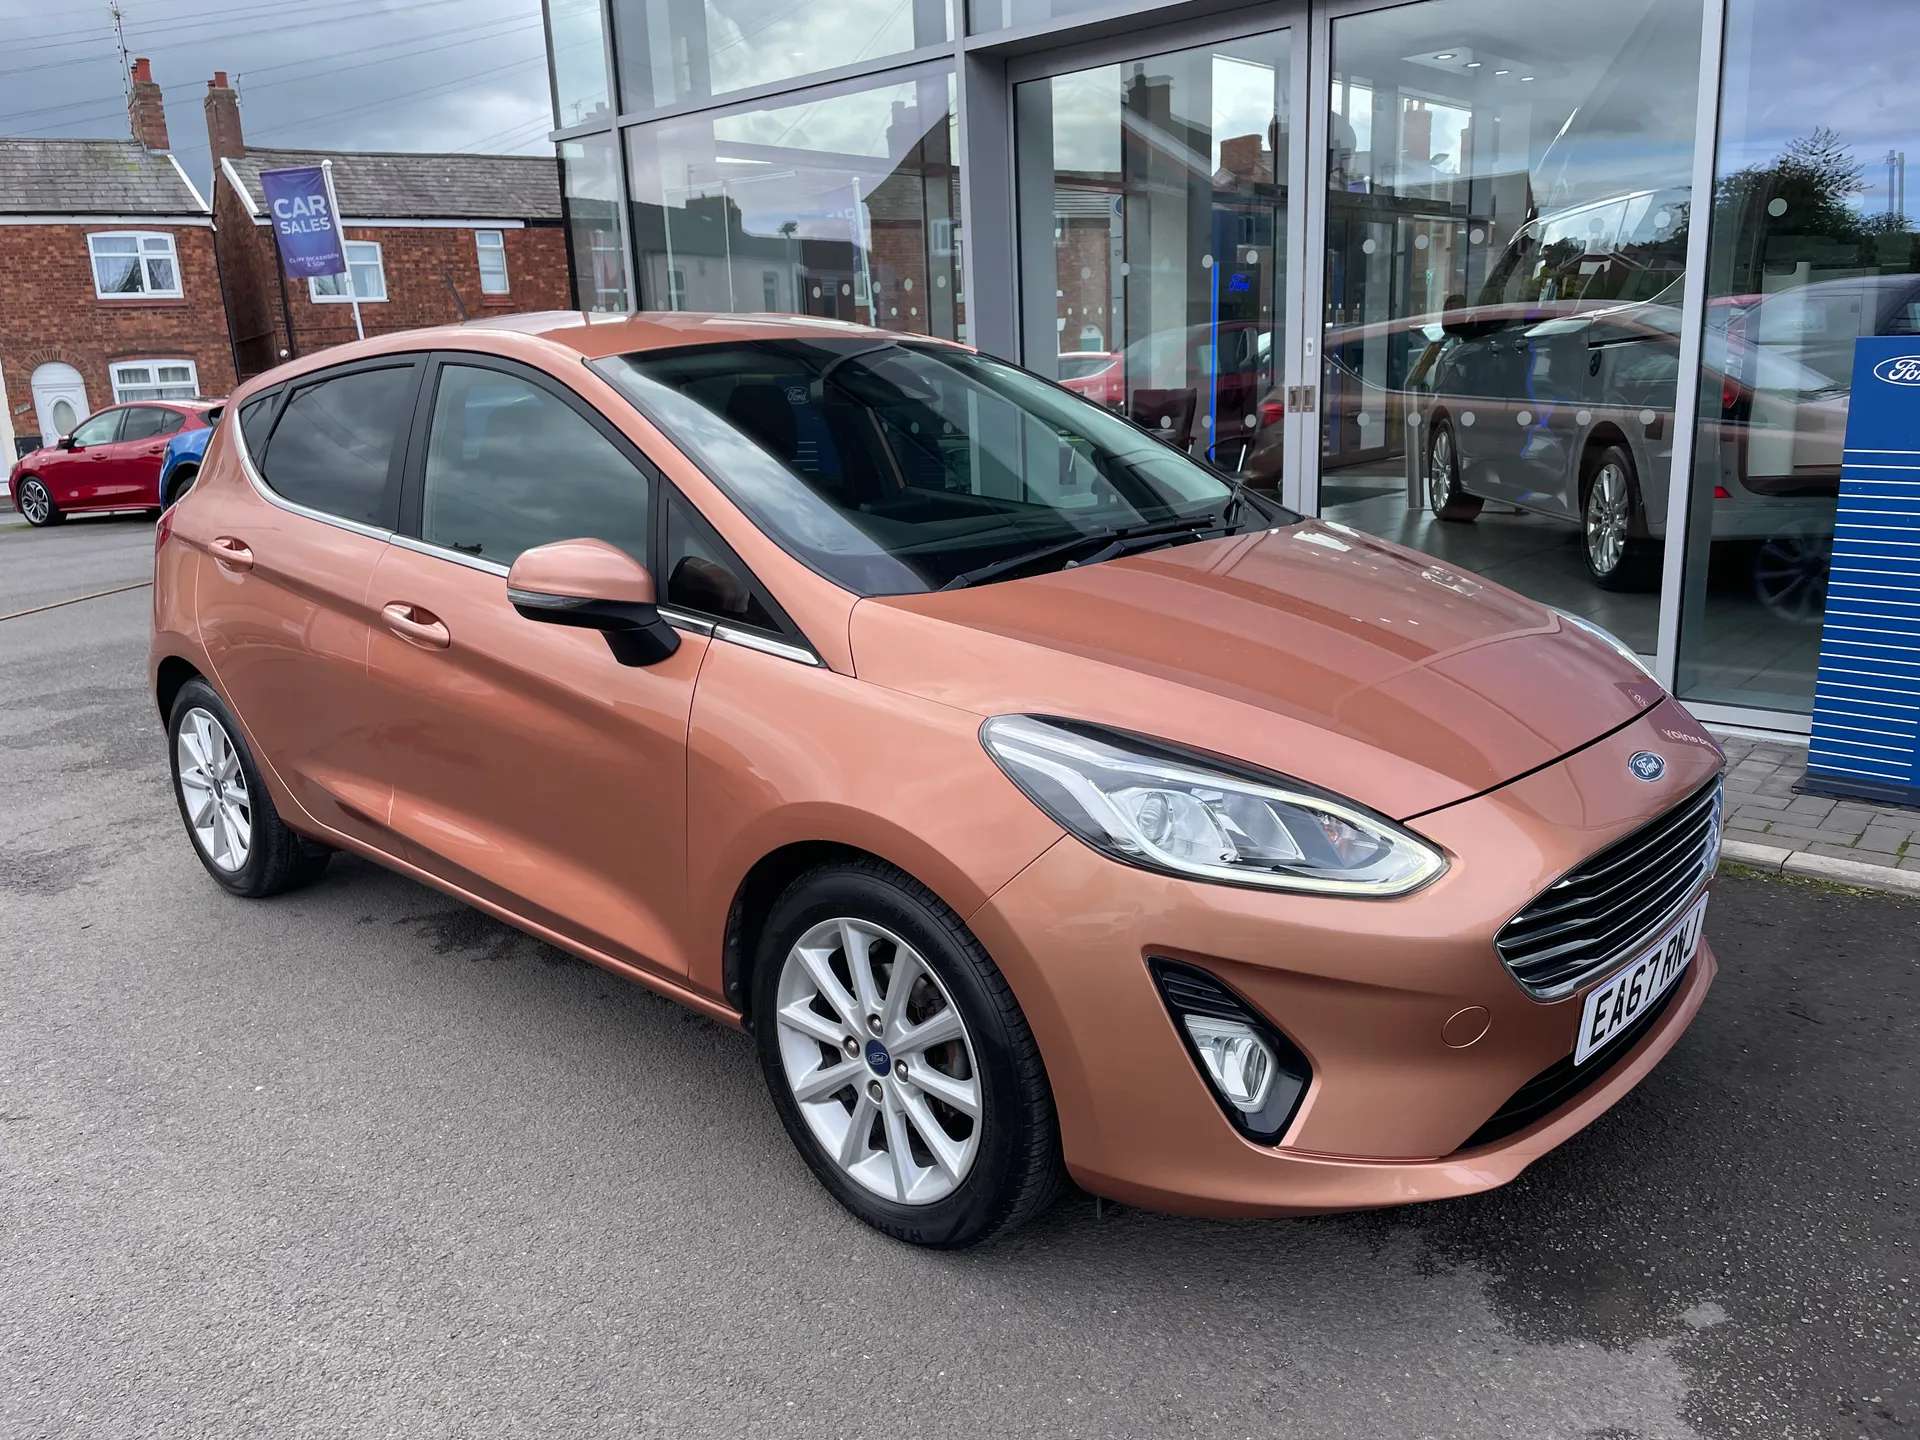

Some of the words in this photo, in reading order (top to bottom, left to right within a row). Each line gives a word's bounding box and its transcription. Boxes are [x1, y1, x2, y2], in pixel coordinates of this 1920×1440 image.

[274, 195, 327, 219] CAR
[280, 217, 331, 235] SALES
[1888, 359, 1920, 380] Fo
[1635, 757, 1660, 776] Ford
[1589, 953, 1661, 1048] EA67
[1659, 908, 1700, 987] RNJ
